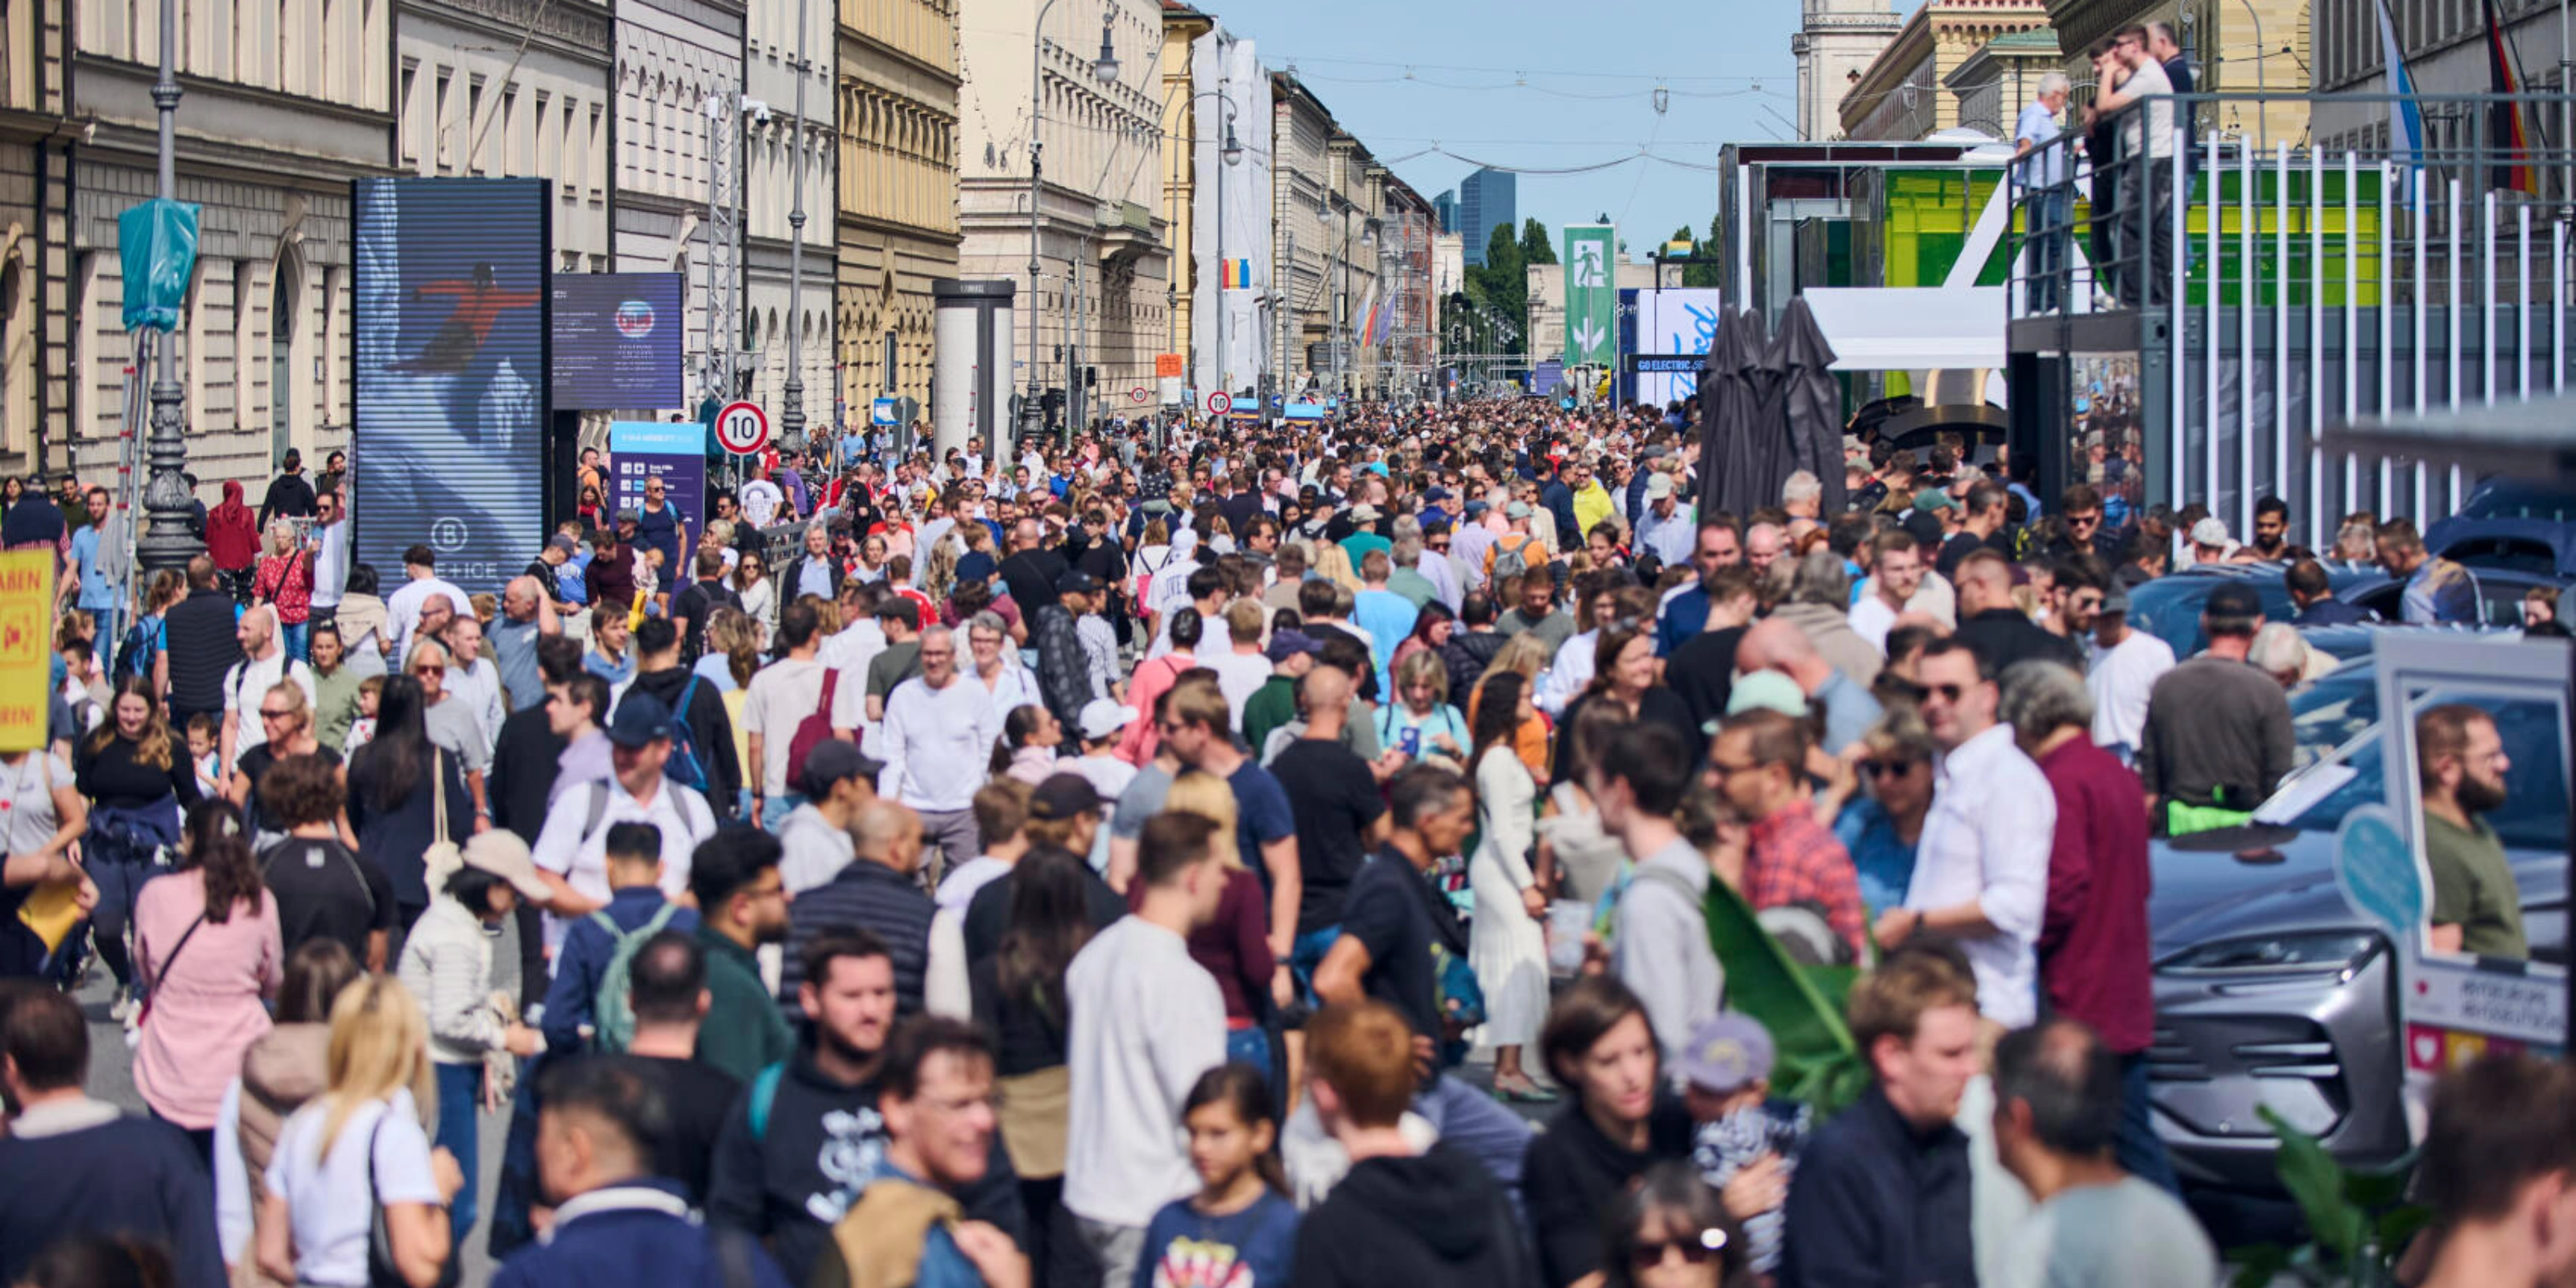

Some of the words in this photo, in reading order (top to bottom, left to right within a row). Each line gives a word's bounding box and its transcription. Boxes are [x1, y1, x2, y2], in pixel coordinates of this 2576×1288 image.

[1638, 360, 1650, 370] GO
[1651, 360, 1690, 370] ELECTRIC
[1136, 390, 1143, 399] 10
[1214, 398, 1225, 409] 10
[730, 416, 755, 440] 10
